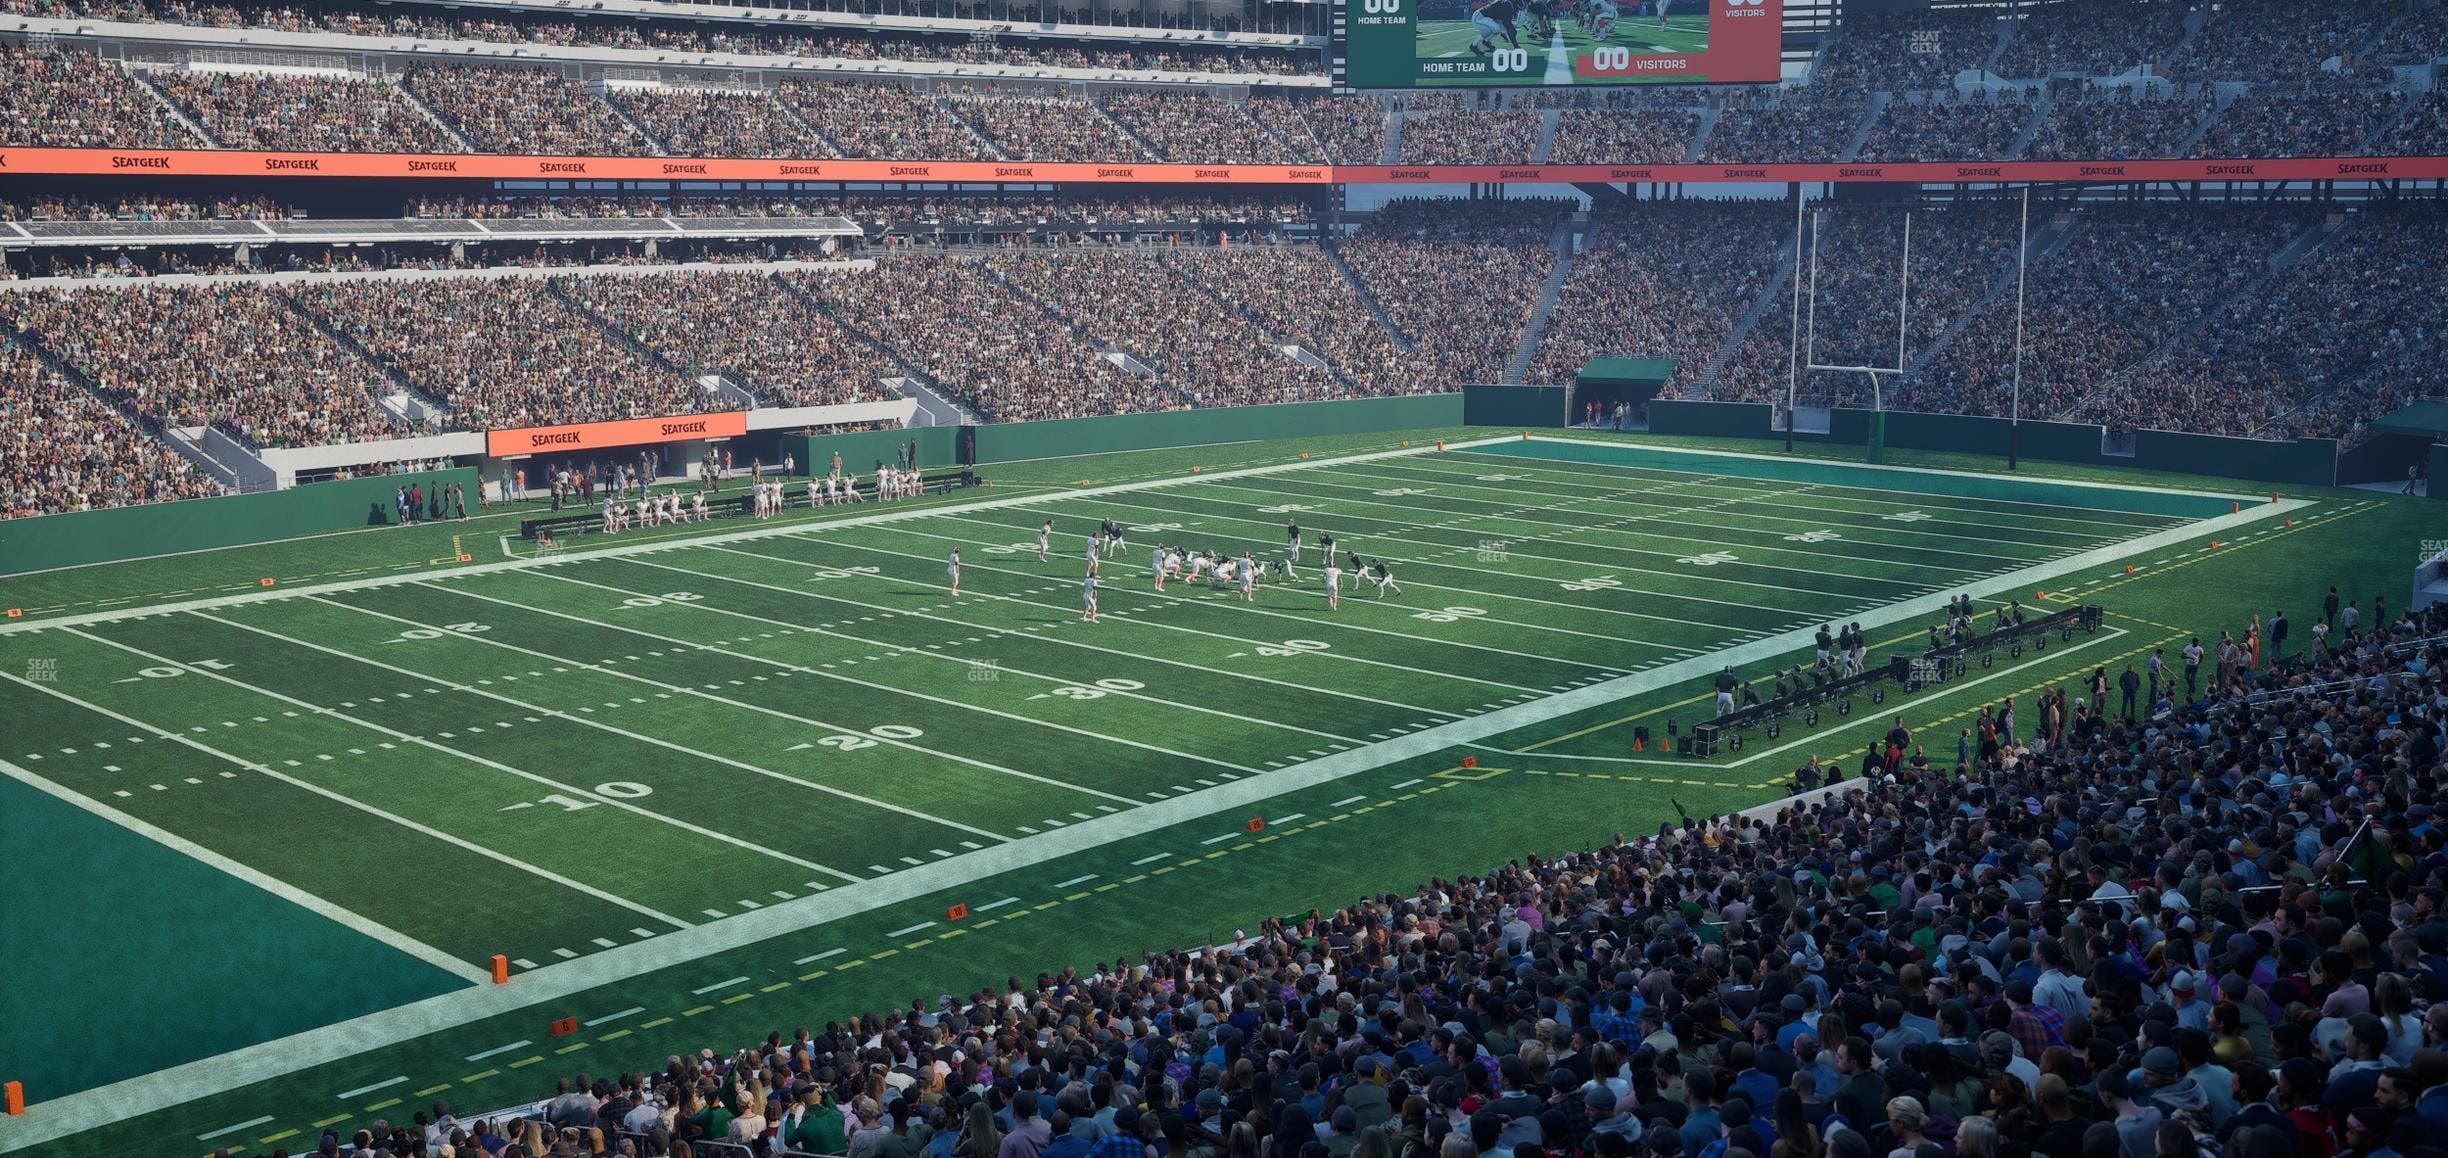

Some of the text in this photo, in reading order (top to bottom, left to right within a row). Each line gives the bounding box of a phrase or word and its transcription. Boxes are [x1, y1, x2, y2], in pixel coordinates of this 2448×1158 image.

[1725, 9, 1766, 17] VISITORS
[1358, 16, 1406, 25] HOME TEAM
[1423, 48, 1528, 73] HOME TEAM 00
[1593, 46, 1687, 71] 00 VISITORS
[113, 157, 169, 168] SEATGEEK
[266, 159, 318, 170] SEATGEEK
[409, 161, 456, 171] SEATGEEK
[540, 163, 585, 172] SEATGEEK
[664, 164, 706, 173] SEATGEEK
[780, 166, 819, 174] SEATGEEK
[891, 167, 928, 175] SEATGEEK
[996, 168, 1032, 176] SEATGEEK
[1098, 169, 1133, 177] SEATGEEK
[1724, 169, 1766, 177] SEATGEEK
[1839, 168, 1882, 177] SEATGEEK
[1957, 167, 2001, 177] SEATGEEK
[2080, 167, 2124, 176] SEATGEEK
[2206, 165, 2254, 175] SEATGEEK
[2337, 163, 2388, 174] SEATGEEK
[1196, 170, 1229, 178] SEATGEEK
[1390, 171, 1430, 179] SEATGEEK
[1500, 170, 1540, 178] SEATGEEK
[1611, 170, 1651, 178] SEATGEEK
[662, 421, 706, 436] SEATGEEK
[532, 431, 580, 446] SEATGEEK
[1410, 606, 1488, 622] 50
[400, 622, 491, 640] 20
[1255, 639, 1331, 657] 40
[138, 659, 235, 678] 10
[1052, 679, 1145, 700] 30
[817, 725, 923, 751] 20
[537, 781, 653, 812] 10
[563, 1021, 570, 1032] G
